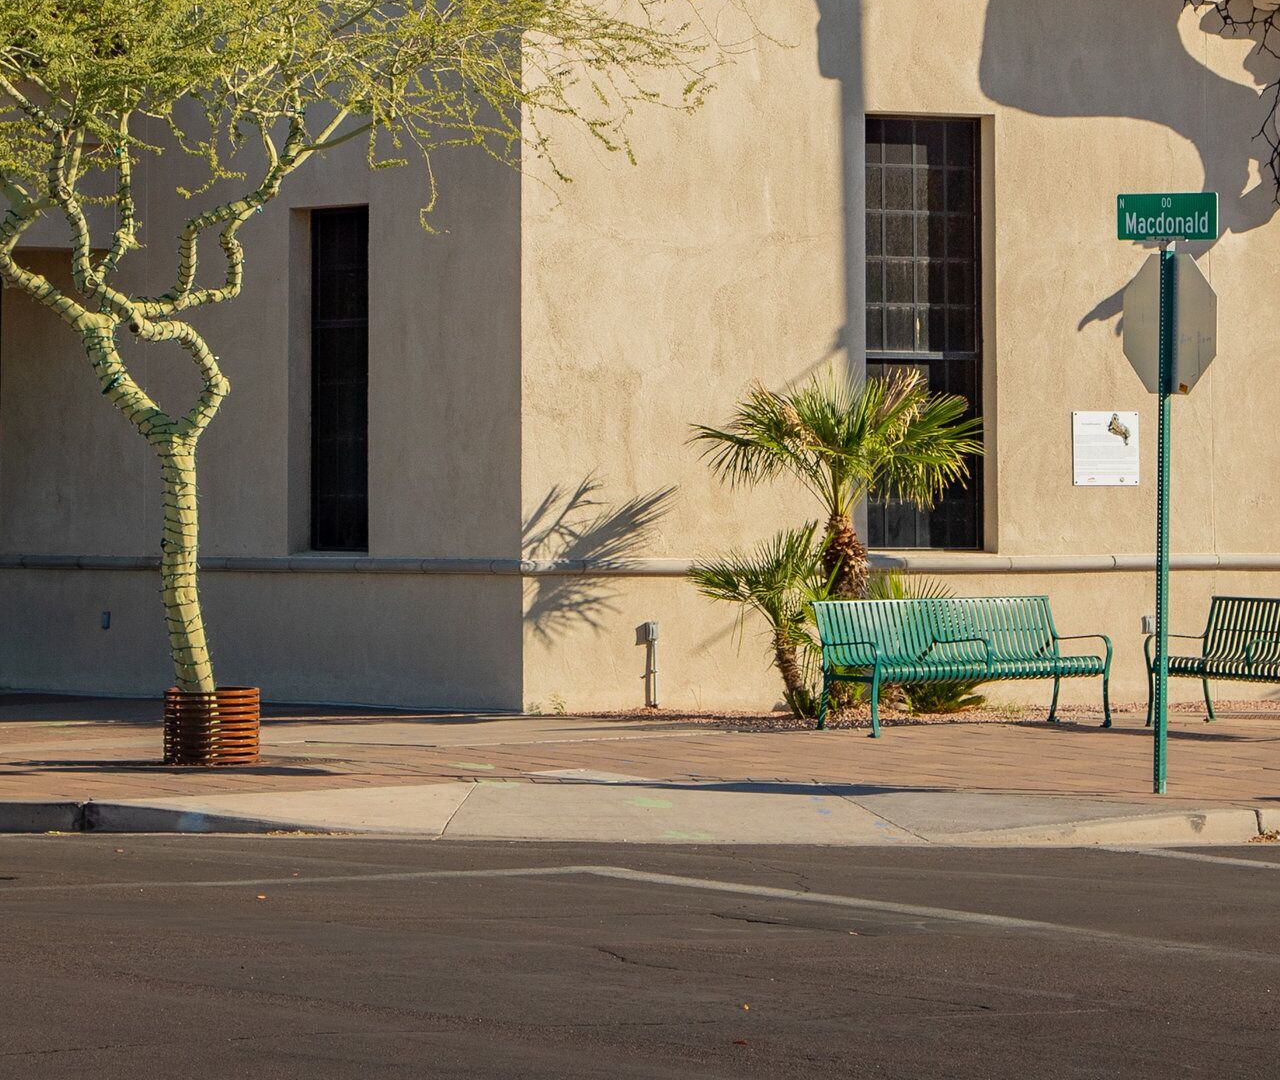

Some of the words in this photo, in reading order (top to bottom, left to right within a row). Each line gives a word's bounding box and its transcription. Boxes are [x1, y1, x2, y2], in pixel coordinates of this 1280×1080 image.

[1119, 198, 1125, 208] N
[1161, 197, 1172, 208] 00
[1125, 211, 1208, 234] Macdonald
